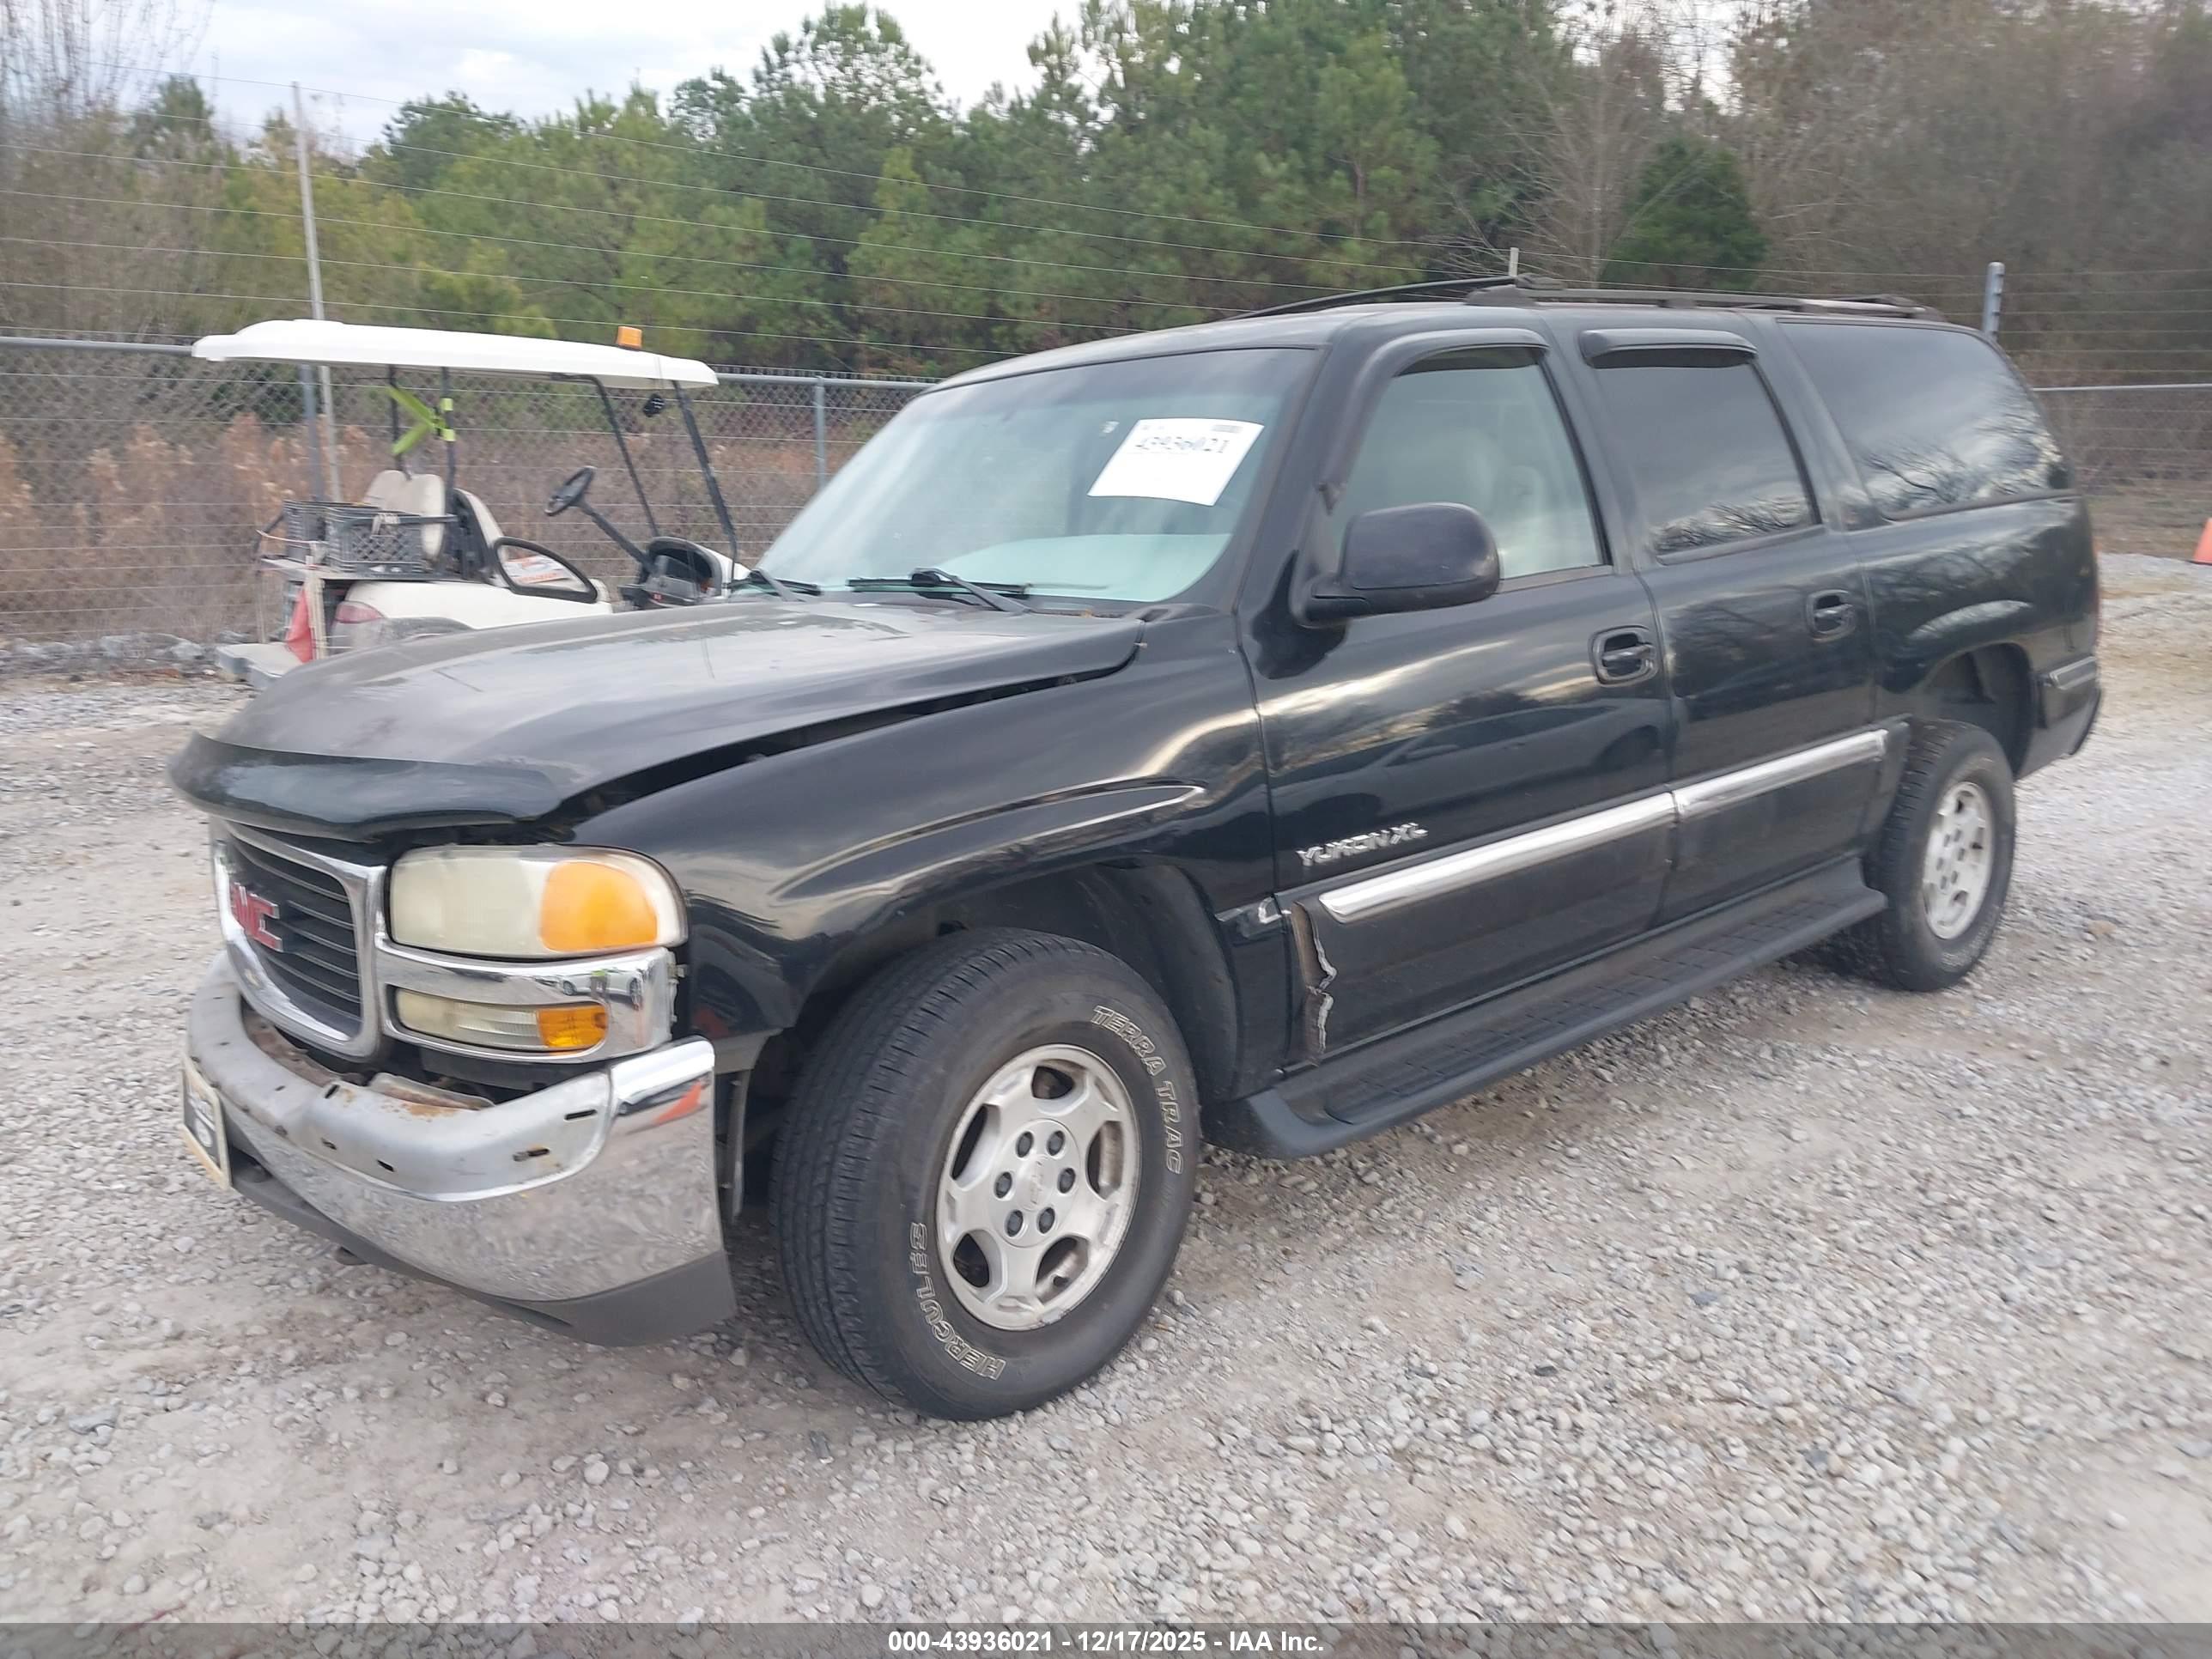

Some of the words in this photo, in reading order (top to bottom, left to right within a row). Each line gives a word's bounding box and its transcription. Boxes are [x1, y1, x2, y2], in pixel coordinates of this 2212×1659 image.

[1296, 830, 1390, 866] YUKON
[1389, 822, 1428, 845] XL
[1090, 1005, 1167, 1076] TERRA
[1155, 1080, 1183, 1175] TRAC
[909, 1222, 1006, 1381] HERCULES
